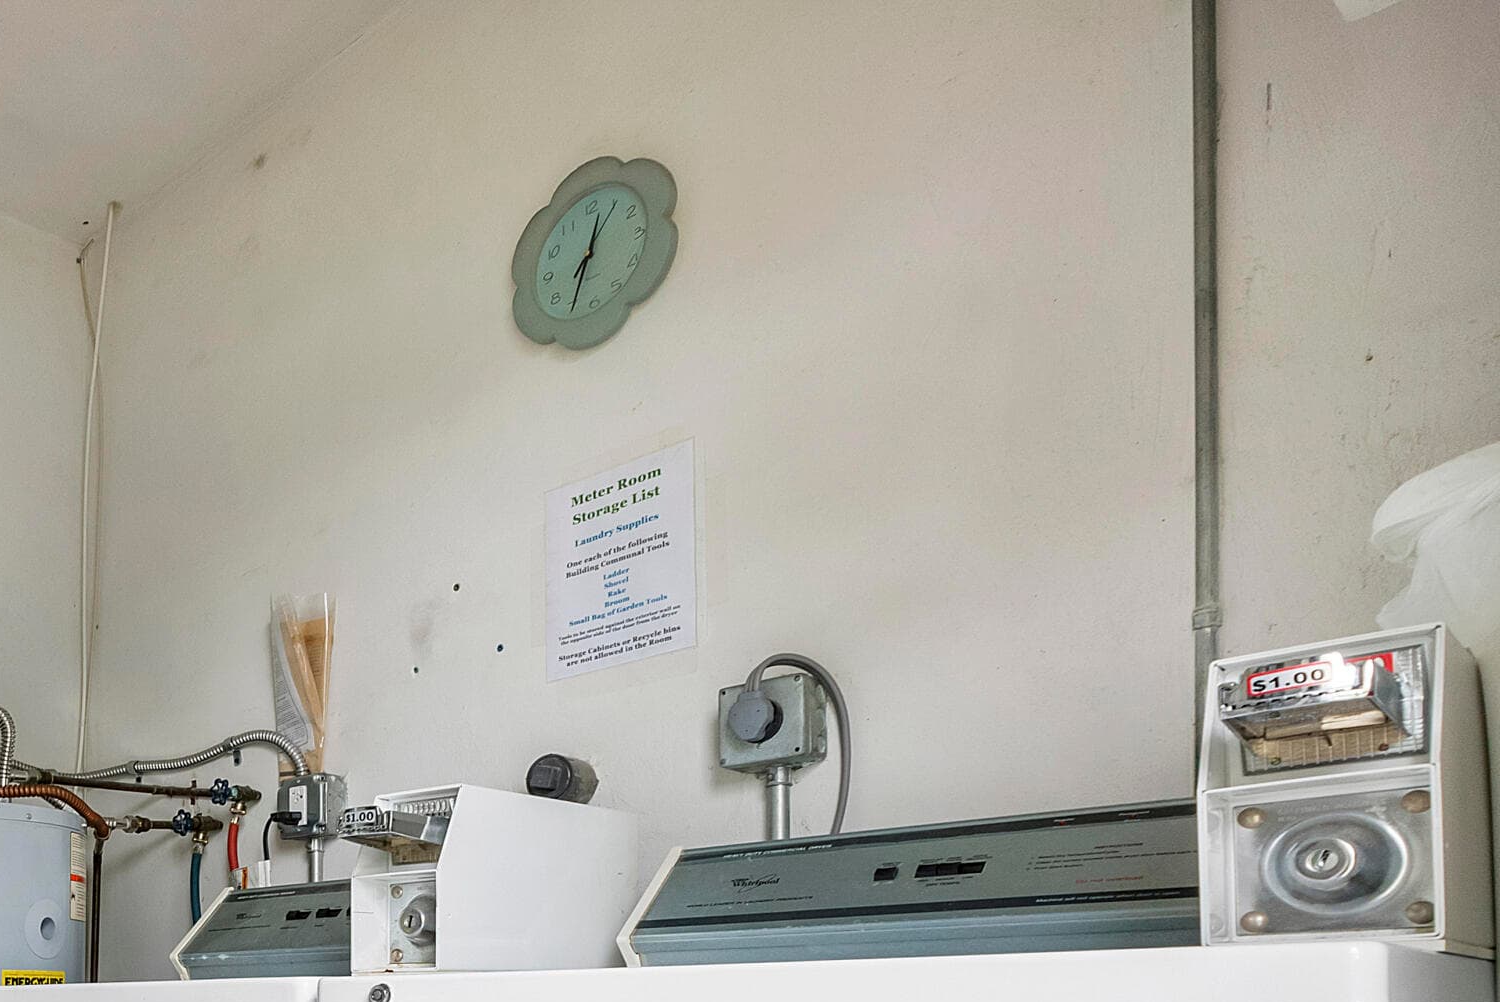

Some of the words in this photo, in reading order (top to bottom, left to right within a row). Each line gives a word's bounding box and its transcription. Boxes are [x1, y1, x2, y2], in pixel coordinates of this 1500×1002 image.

[585, 200, 599, 216] 12
[626, 204, 637, 220] 2
[634, 226, 645, 240] 3
[549, 245, 561, 260] 10
[627, 253, 638, 268] 4
[542, 271, 554, 285] 9
[611, 279, 622, 294] 5
[550, 292, 561, 306] 8
[589, 296, 600, 309] 6
[571, 485, 614, 508] Meter
[617, 468, 662, 490] Room
[572, 499, 628, 525] Storage
[632, 486, 660, 505] List
[575, 528, 614, 547] Laundry
[615, 514, 660, 532] Supplies
[566, 560, 582, 569] One
[584, 553, 602, 563] each
[603, 549, 613, 557] of
[613, 545, 626, 554] the
[627, 531, 668, 549] following
[565, 563, 599, 579] Building
[600, 549, 645, 567] Communal
[646, 541, 670, 552] Tools
[603, 567, 630, 580] Ladder
[558, 651, 587, 662] Storage
[588, 641, 621, 654] Cabinets
[632, 630, 662, 643] Recycle
[594, 648, 624, 660] allowed
[648, 635, 672, 646] Room
[346, 811, 374, 823] $1.00
[731, 876, 780, 890] Whirlpool
